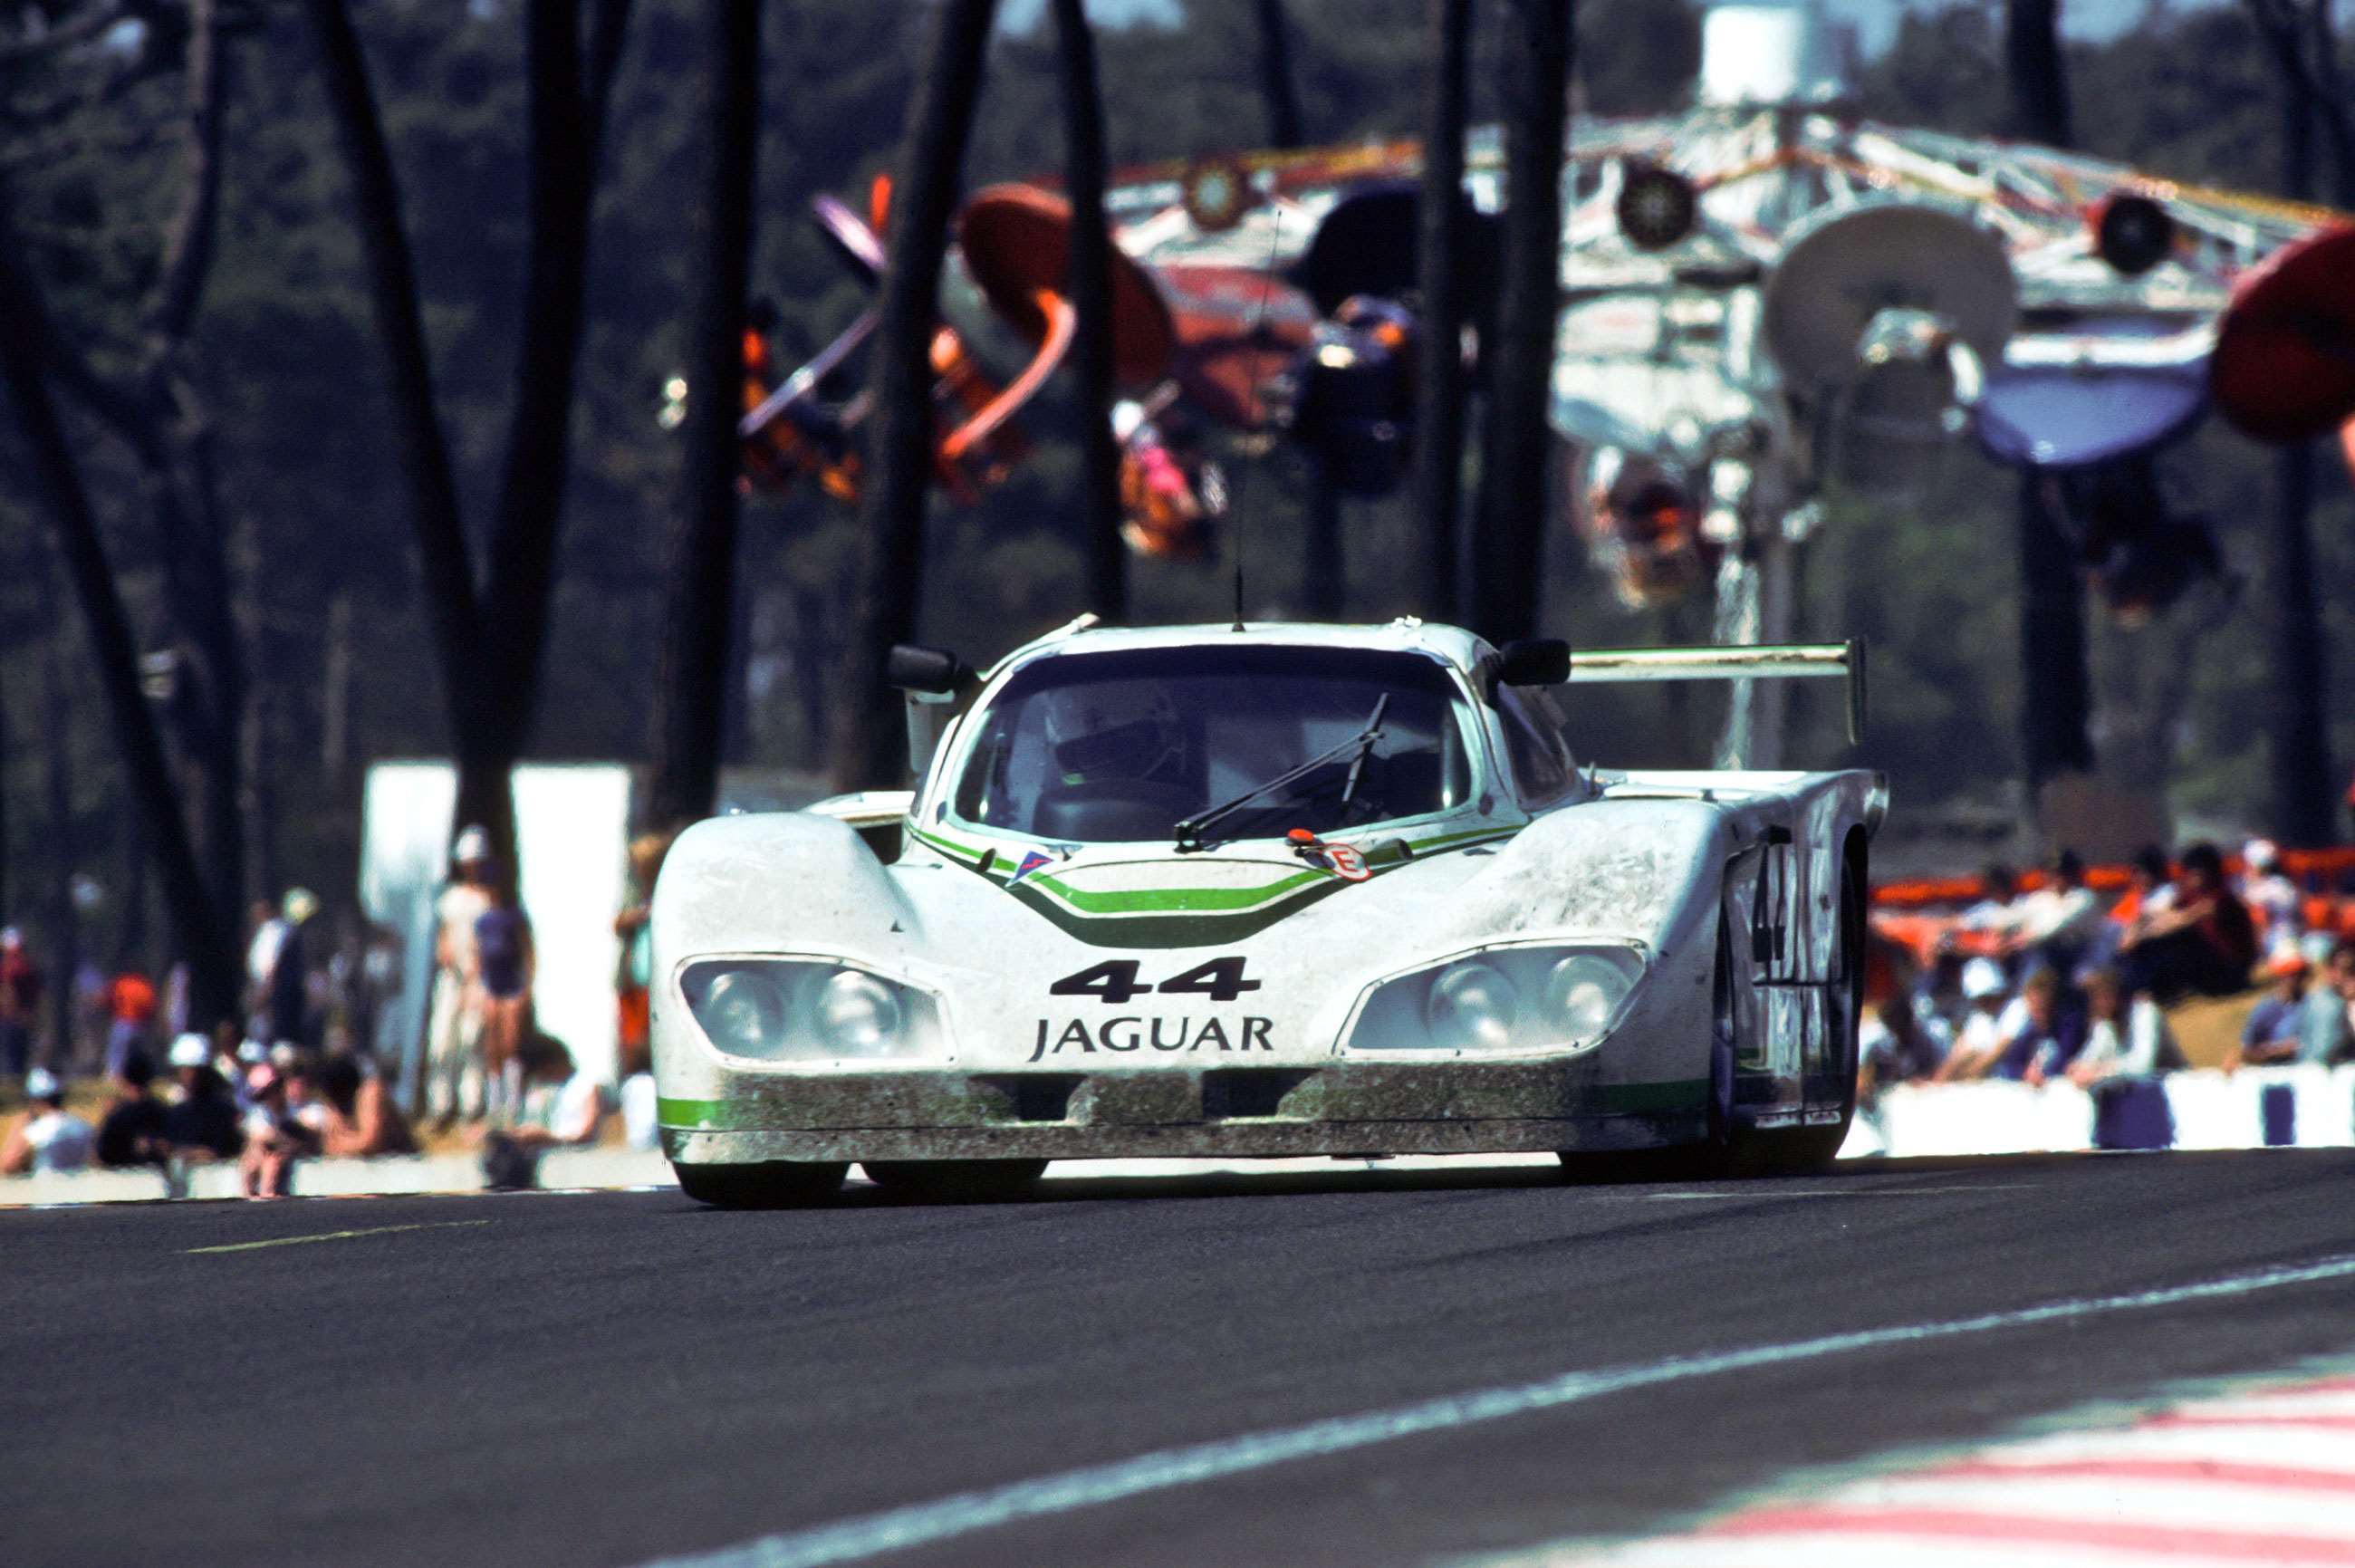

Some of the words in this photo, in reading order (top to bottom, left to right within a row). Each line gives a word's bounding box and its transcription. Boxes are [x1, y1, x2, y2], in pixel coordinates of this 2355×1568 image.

[1331, 851, 1359, 872] E
[1049, 956, 1262, 1004] 44
[1026, 1015, 1274, 1063] JAGUAR
